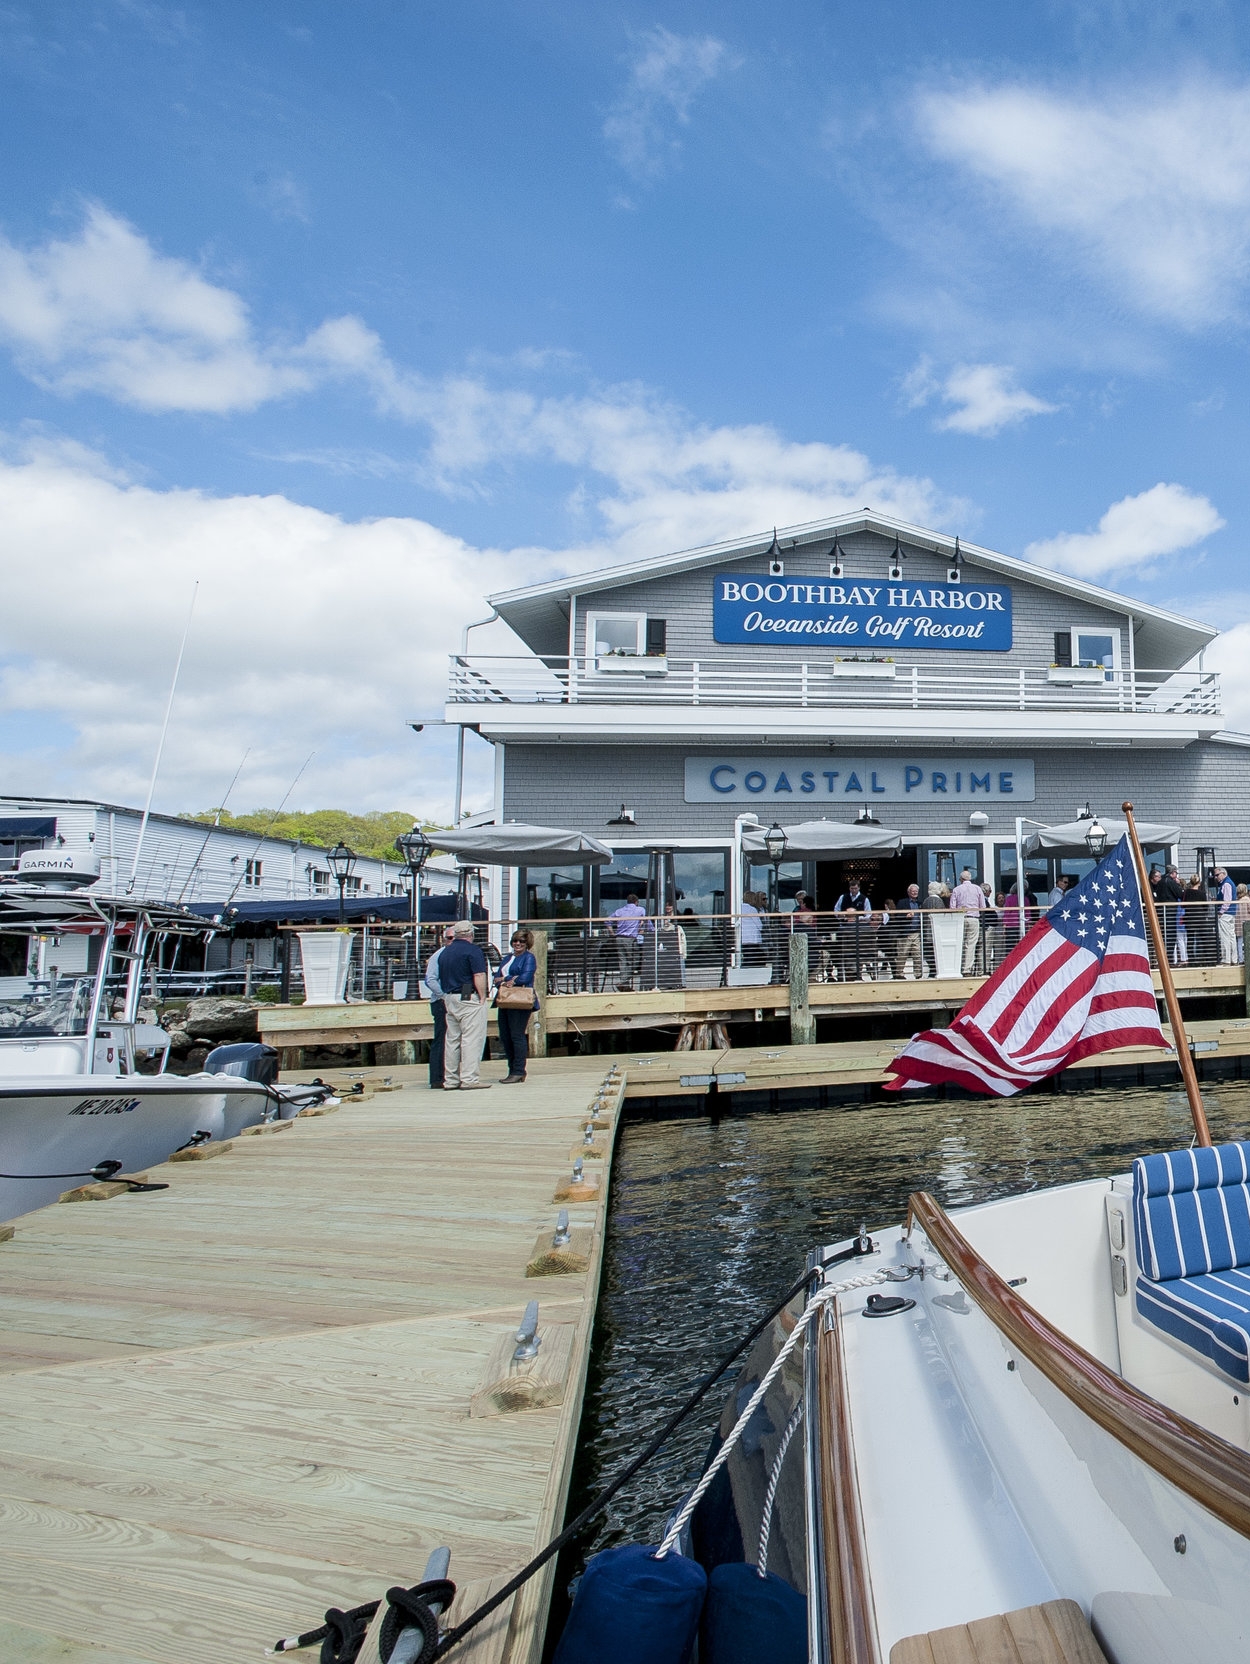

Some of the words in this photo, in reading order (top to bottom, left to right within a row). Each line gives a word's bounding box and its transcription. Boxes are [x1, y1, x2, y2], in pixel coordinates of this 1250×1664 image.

[721, 581, 882, 606] BOOTHBAY
[887, 588, 1006, 611] HARBOR
[743, 611, 859, 634] Oceanside
[865, 615, 913, 640] Golf
[914, 616, 985, 639] Resort
[710, 764, 886, 793] COASTAL
[905, 765, 1014, 793] PRIME
[24, 860, 74, 869] GARMIN
